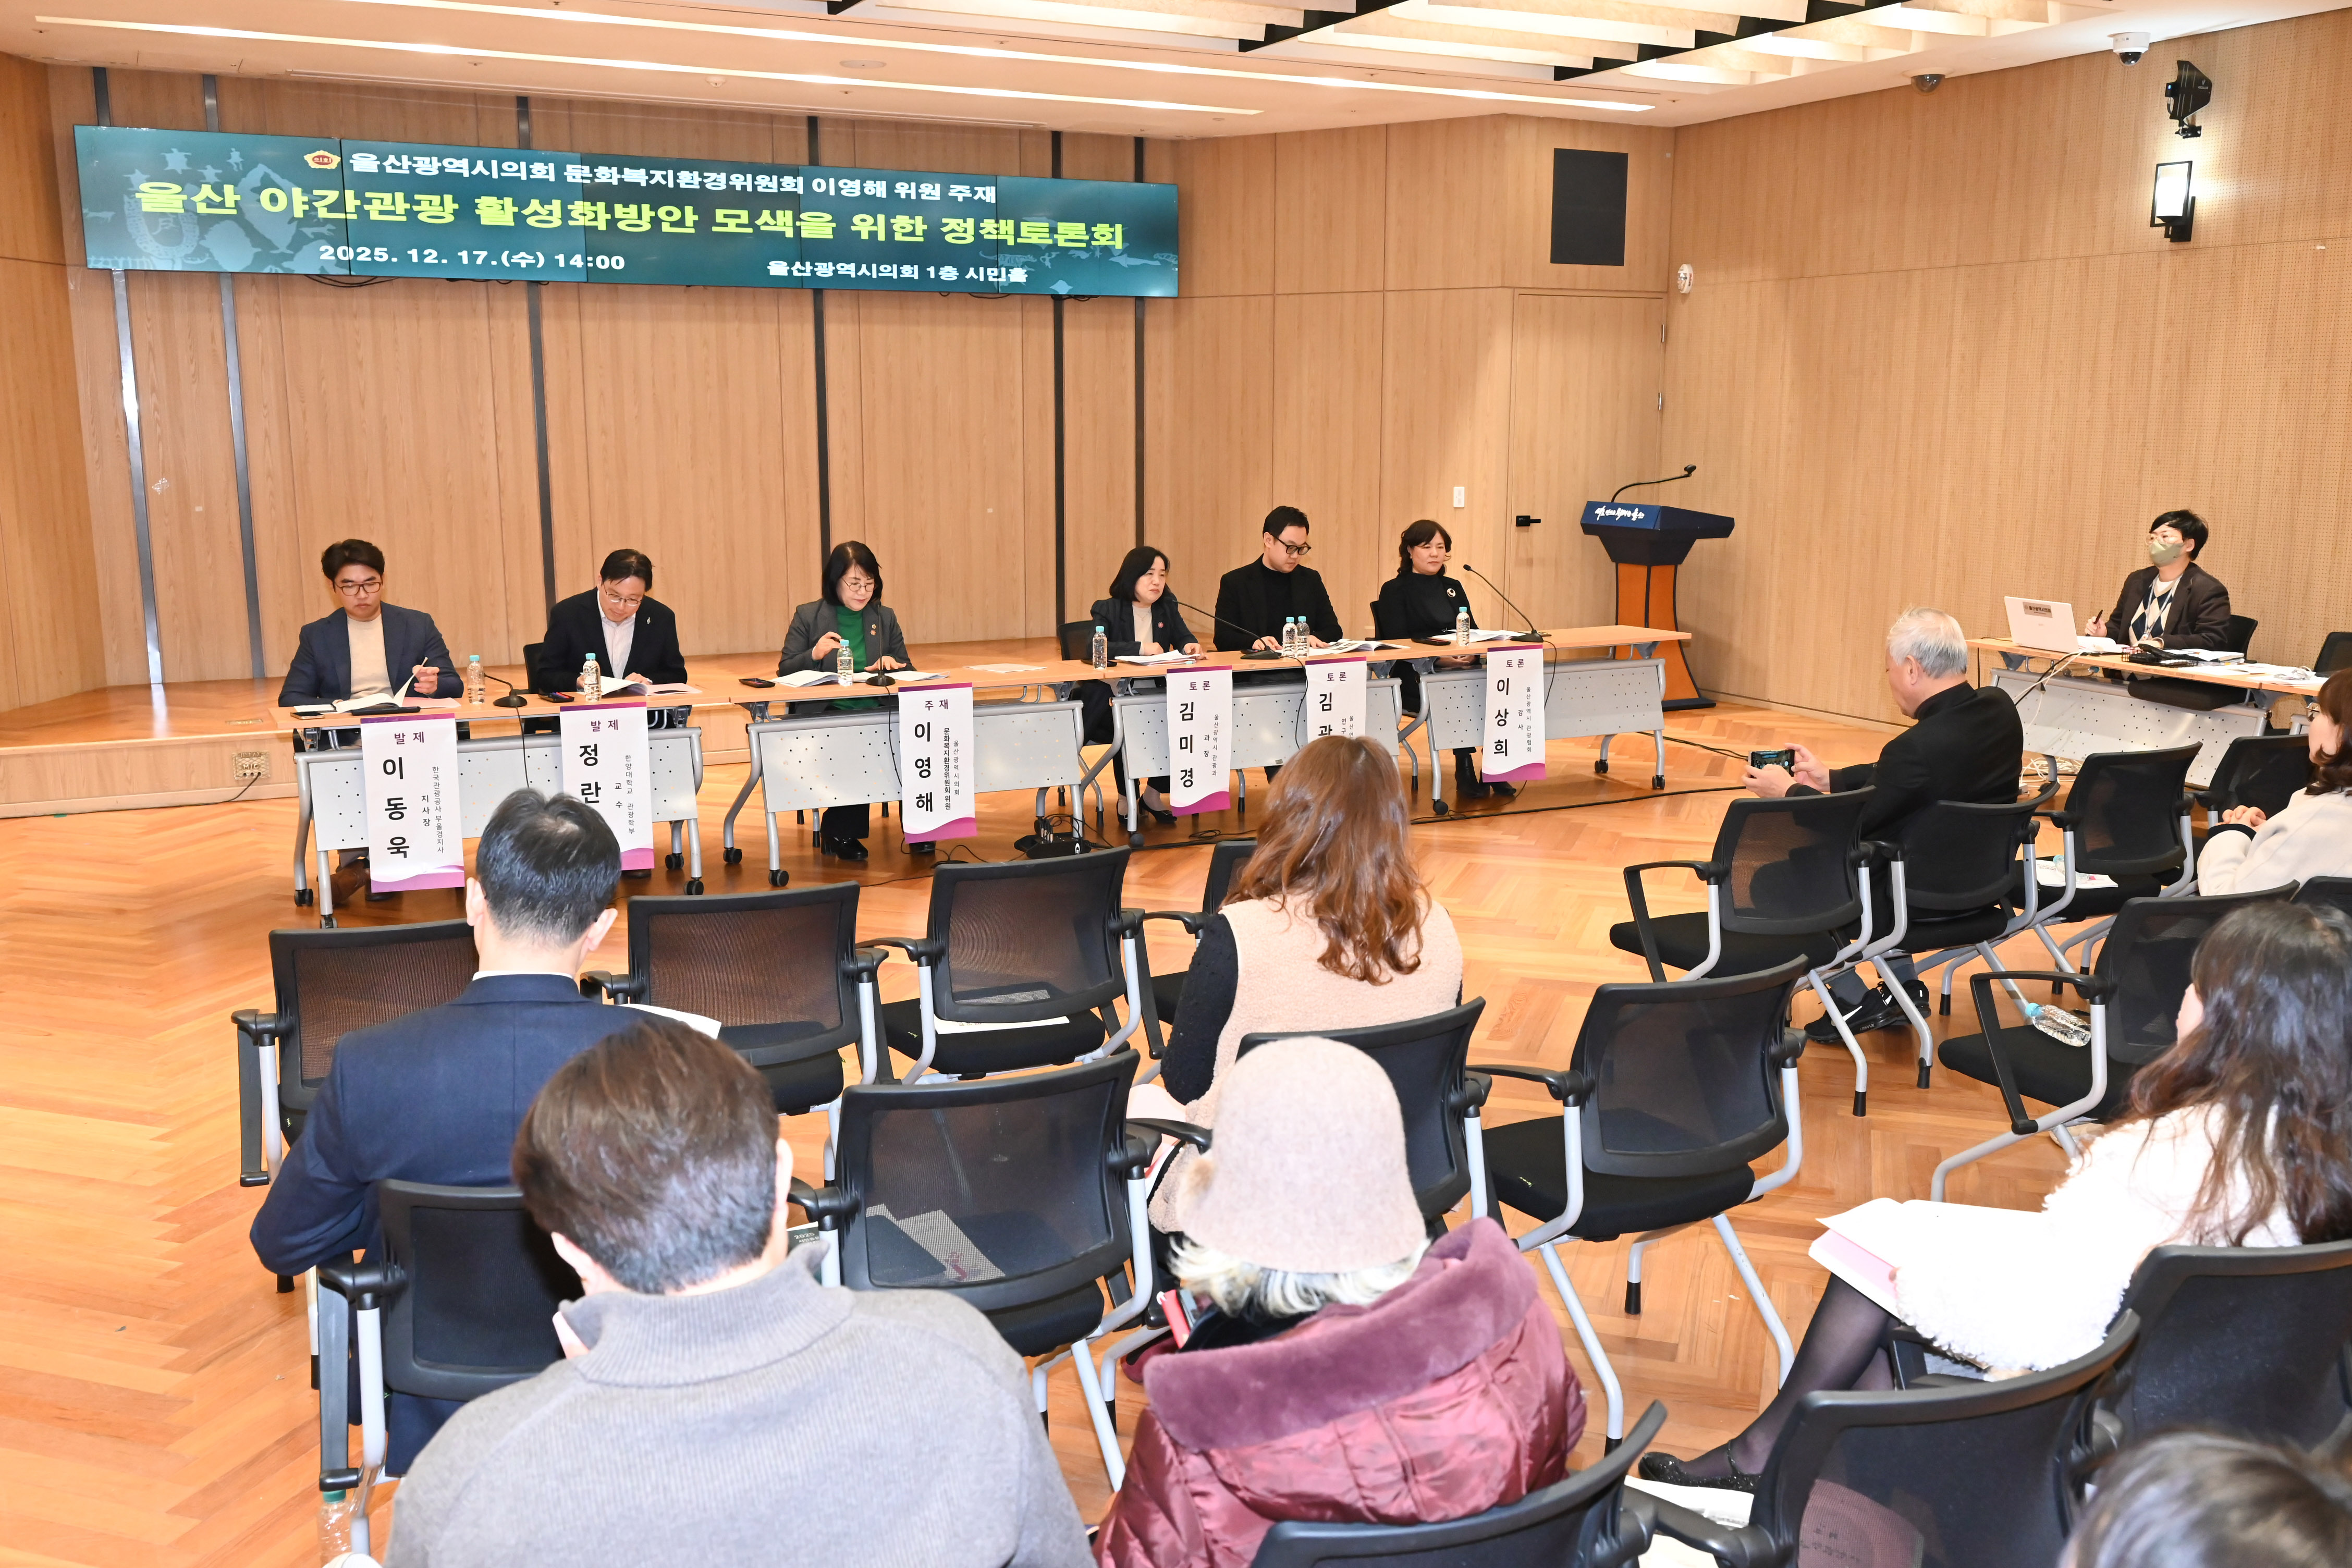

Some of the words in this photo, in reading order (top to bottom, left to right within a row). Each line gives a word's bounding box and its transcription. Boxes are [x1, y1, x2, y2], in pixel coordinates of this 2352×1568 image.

[349, 153, 555, 182] 울산광역시의회
[564, 164, 804, 194] 문화복지환경위원회
[812, 178, 887, 198] 이영해
[894, 182, 940, 200] 위원
[948, 185, 996, 203] 주재
[134, 181, 241, 216] 울산
[260, 188, 459, 224] 야간관광
[475, 196, 699, 234] 활성화방안
[712, 209, 836, 239] 모색을
[850, 214, 928, 242] 위한
[940, 217, 1123, 249] 정책토론회
[319, 245, 398, 262] 2025.
[407, 249, 448, 263] 12.
[458, 250, 545, 268] 17.(수)
[555, 253, 625, 270] 14:00
[767, 261, 918, 279] 울산광역시의회
[926, 265, 959, 280] 1층
[965, 267, 1028, 283] 시민홀
[1506, 658, 1525, 668] 토론
[1189, 680, 1211, 691] 토론
[1327, 671, 1347, 681] 토론
[924, 699, 948, 711] 주재
[1493, 678, 1510, 757] 이상희
[591, 719, 619, 732] 발제
[1517, 709, 1523, 730] 감사
[394, 731, 424, 745] 발제
[1179, 702, 1194, 788] 김미경
[1204, 734, 1210, 757] 과장
[579, 743, 602, 804] 정란
[914, 721, 933, 812] 이영해
[432, 766, 442, 813] 한국관광공사
[615, 782, 623, 808] 교수
[383, 756, 410, 859] 이동욱
[421, 794, 431, 827] 지사장
[945, 795, 951, 810] 위원
[435, 815, 444, 853] 부울경지사
